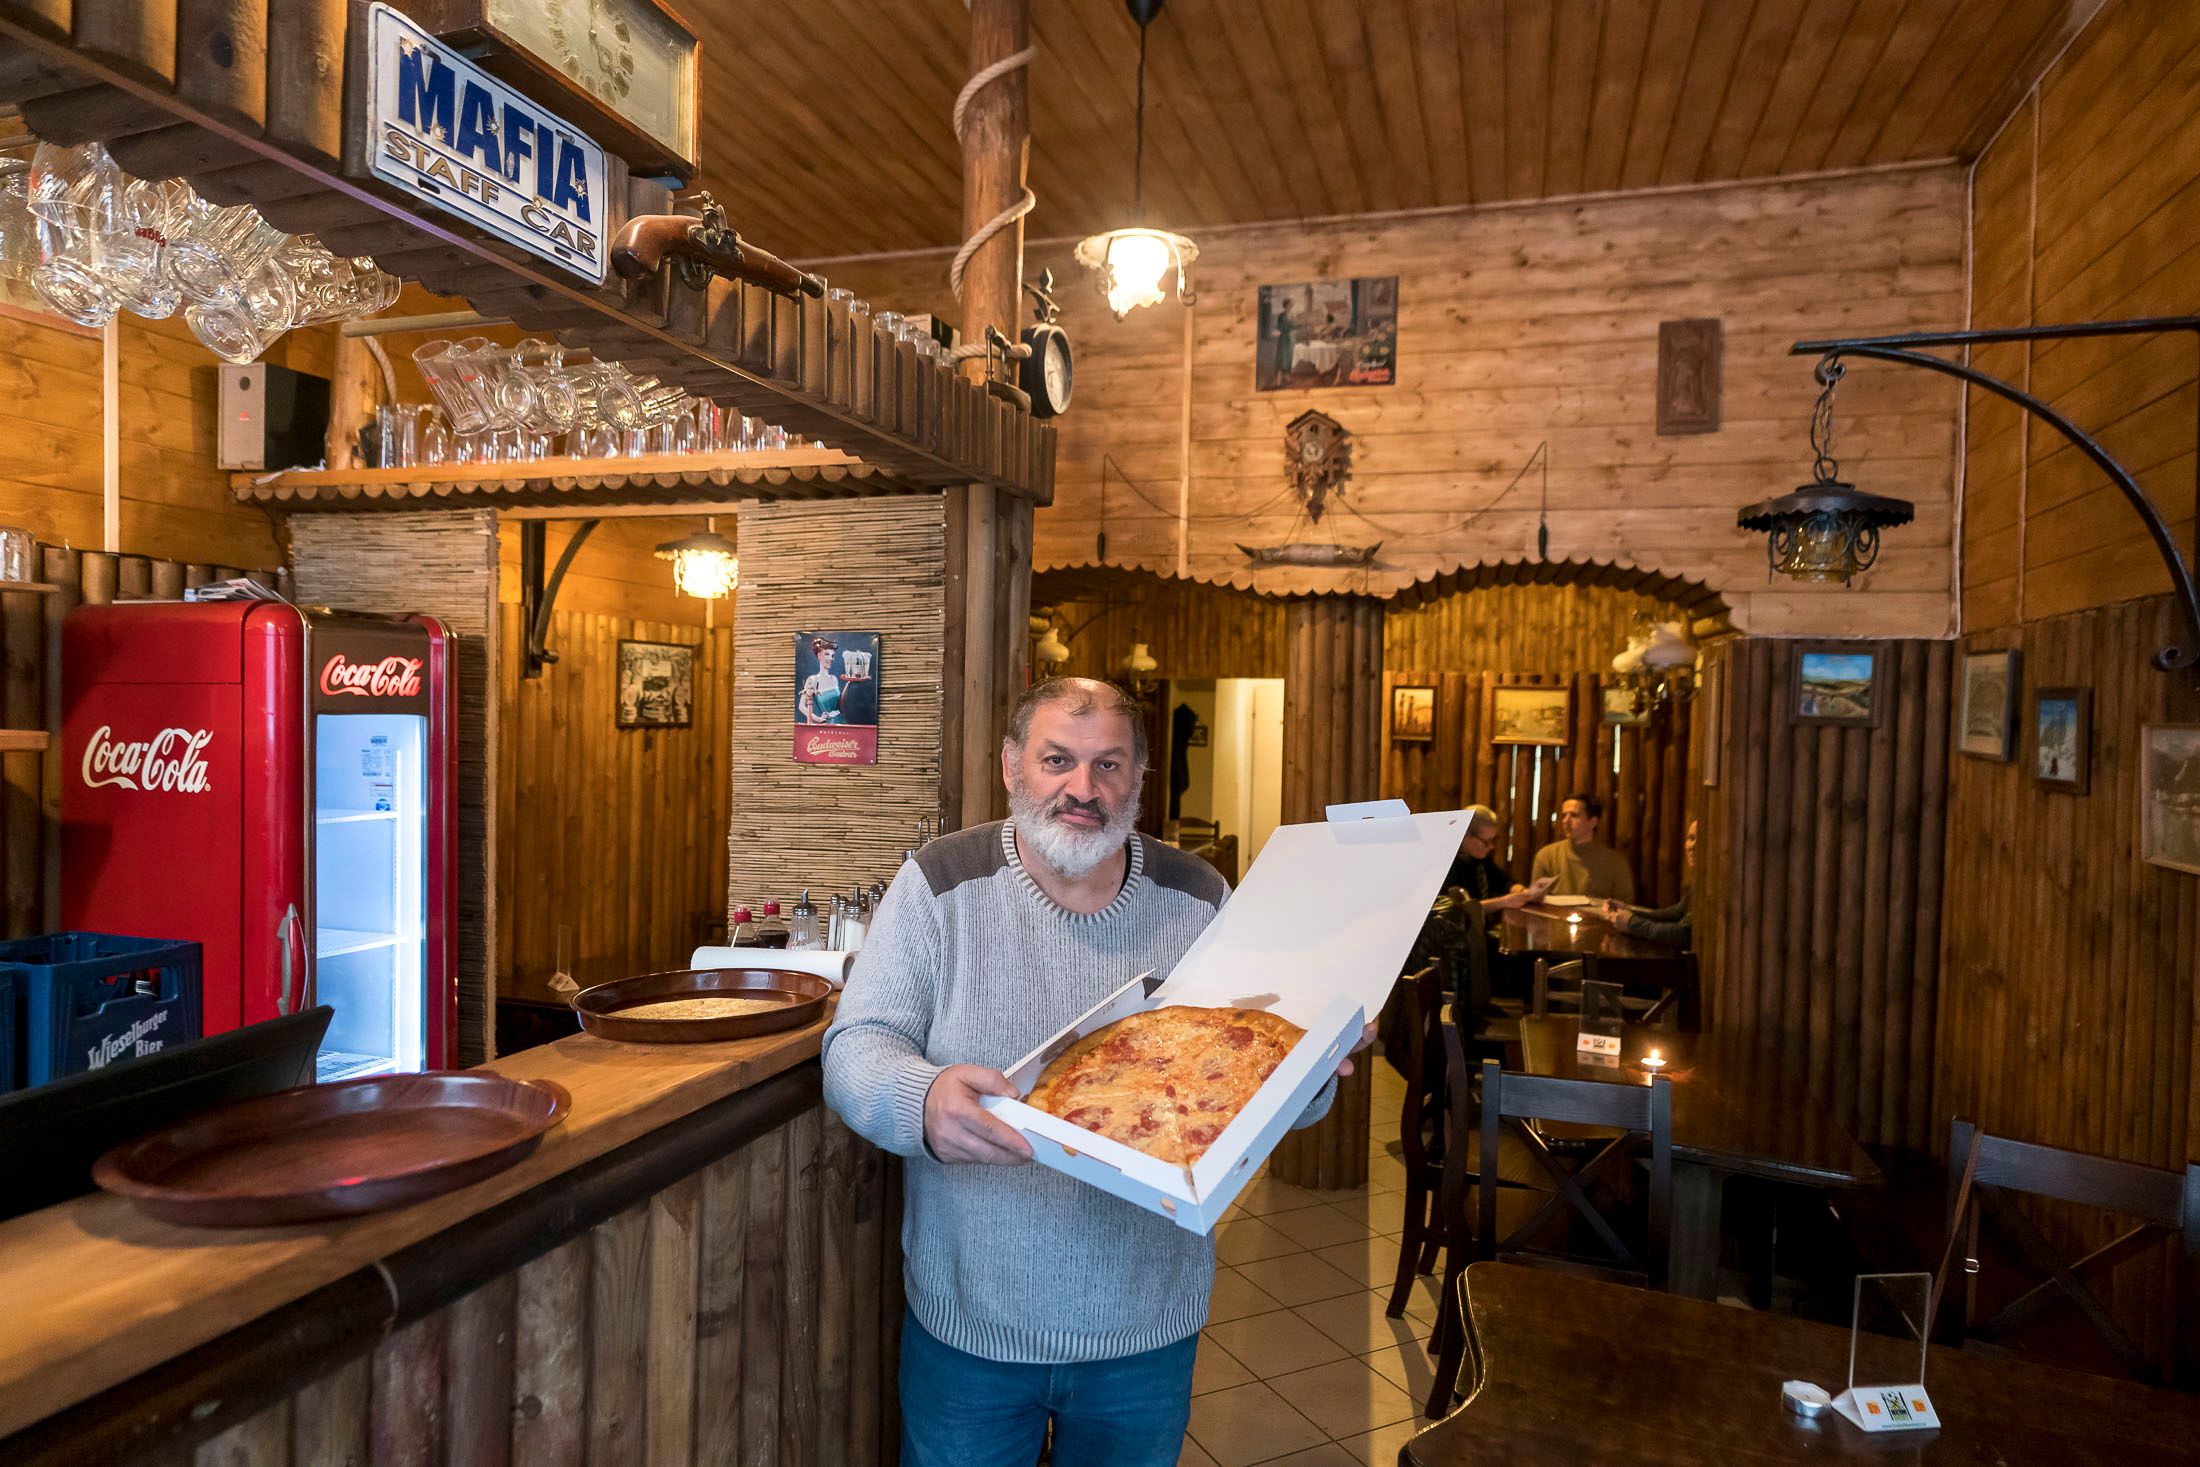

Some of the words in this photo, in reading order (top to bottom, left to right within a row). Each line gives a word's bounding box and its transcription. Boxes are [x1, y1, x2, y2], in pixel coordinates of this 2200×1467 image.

[398, 40, 591, 223] MAFIA
[386, 130, 499, 204] STAFF
[521, 204, 597, 259] CAR
[320, 653, 423, 697] Coca-Cola
[82, 725, 213, 794] Coca-Cola
[806, 736, 860, 756] Budweiser
[87, 1010, 168, 1071] Wieselburger
[135, 1039, 163, 1058] Bier
